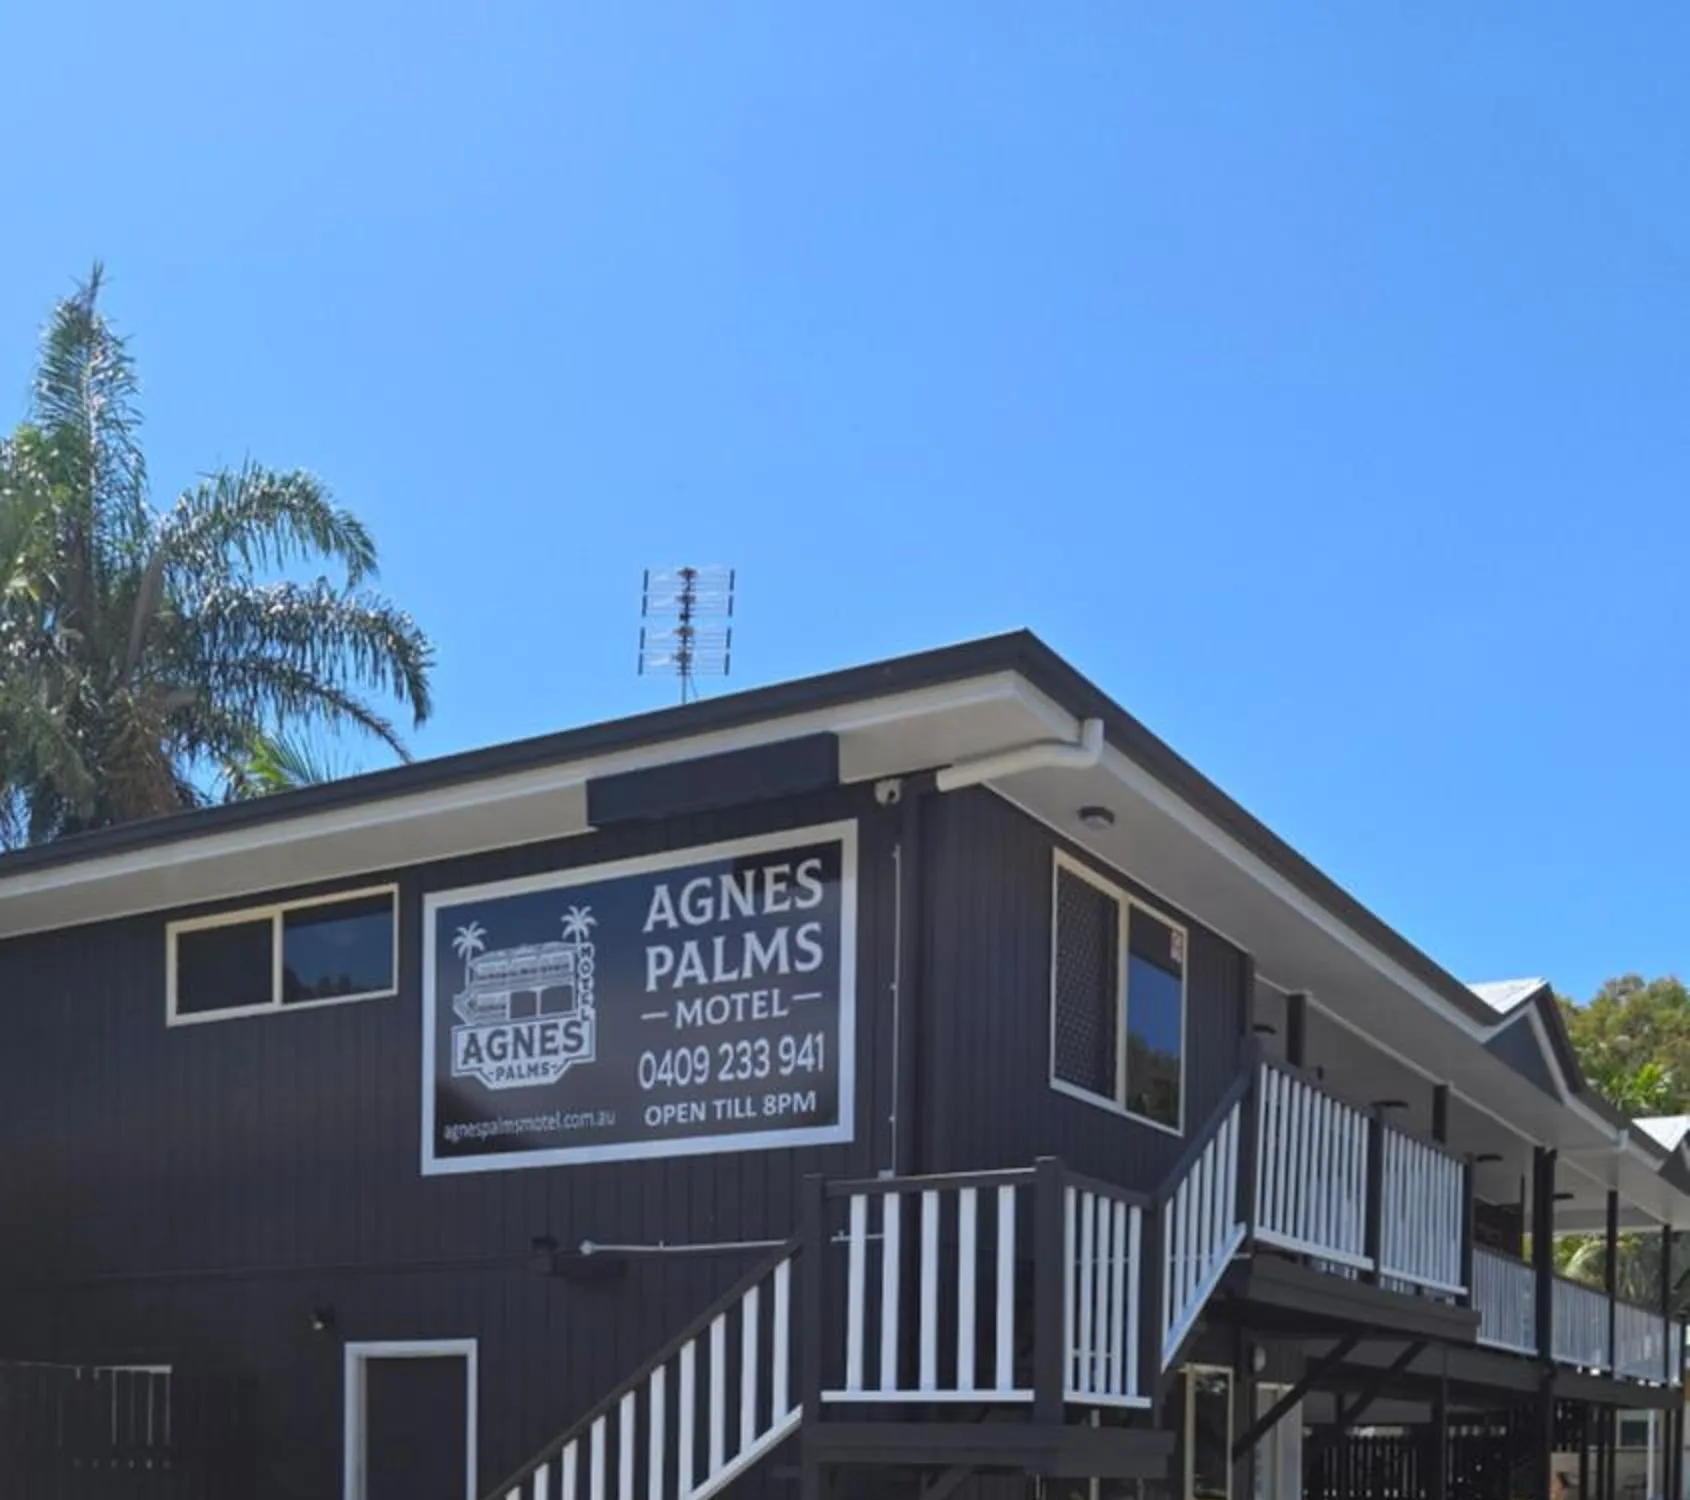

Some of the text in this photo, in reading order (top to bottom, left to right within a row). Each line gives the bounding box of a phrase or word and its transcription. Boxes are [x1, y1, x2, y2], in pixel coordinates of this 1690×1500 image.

[641, 858, 823, 933] AGNES
[645, 921, 823, 992] PALMS
[577, 942, 595, 1021] MOTEL
[675, 988, 789, 1029] MOTEL
[461, 1020, 584, 1066] AGNES
[638, 1031, 825, 1089] 0409 233 941
[495, 1061, 554, 1081] PALMS
[443, 1110, 616, 1143] agnespalmsmotel.com.au
[644, 1090, 817, 1126] OPEN TILL 8PM
